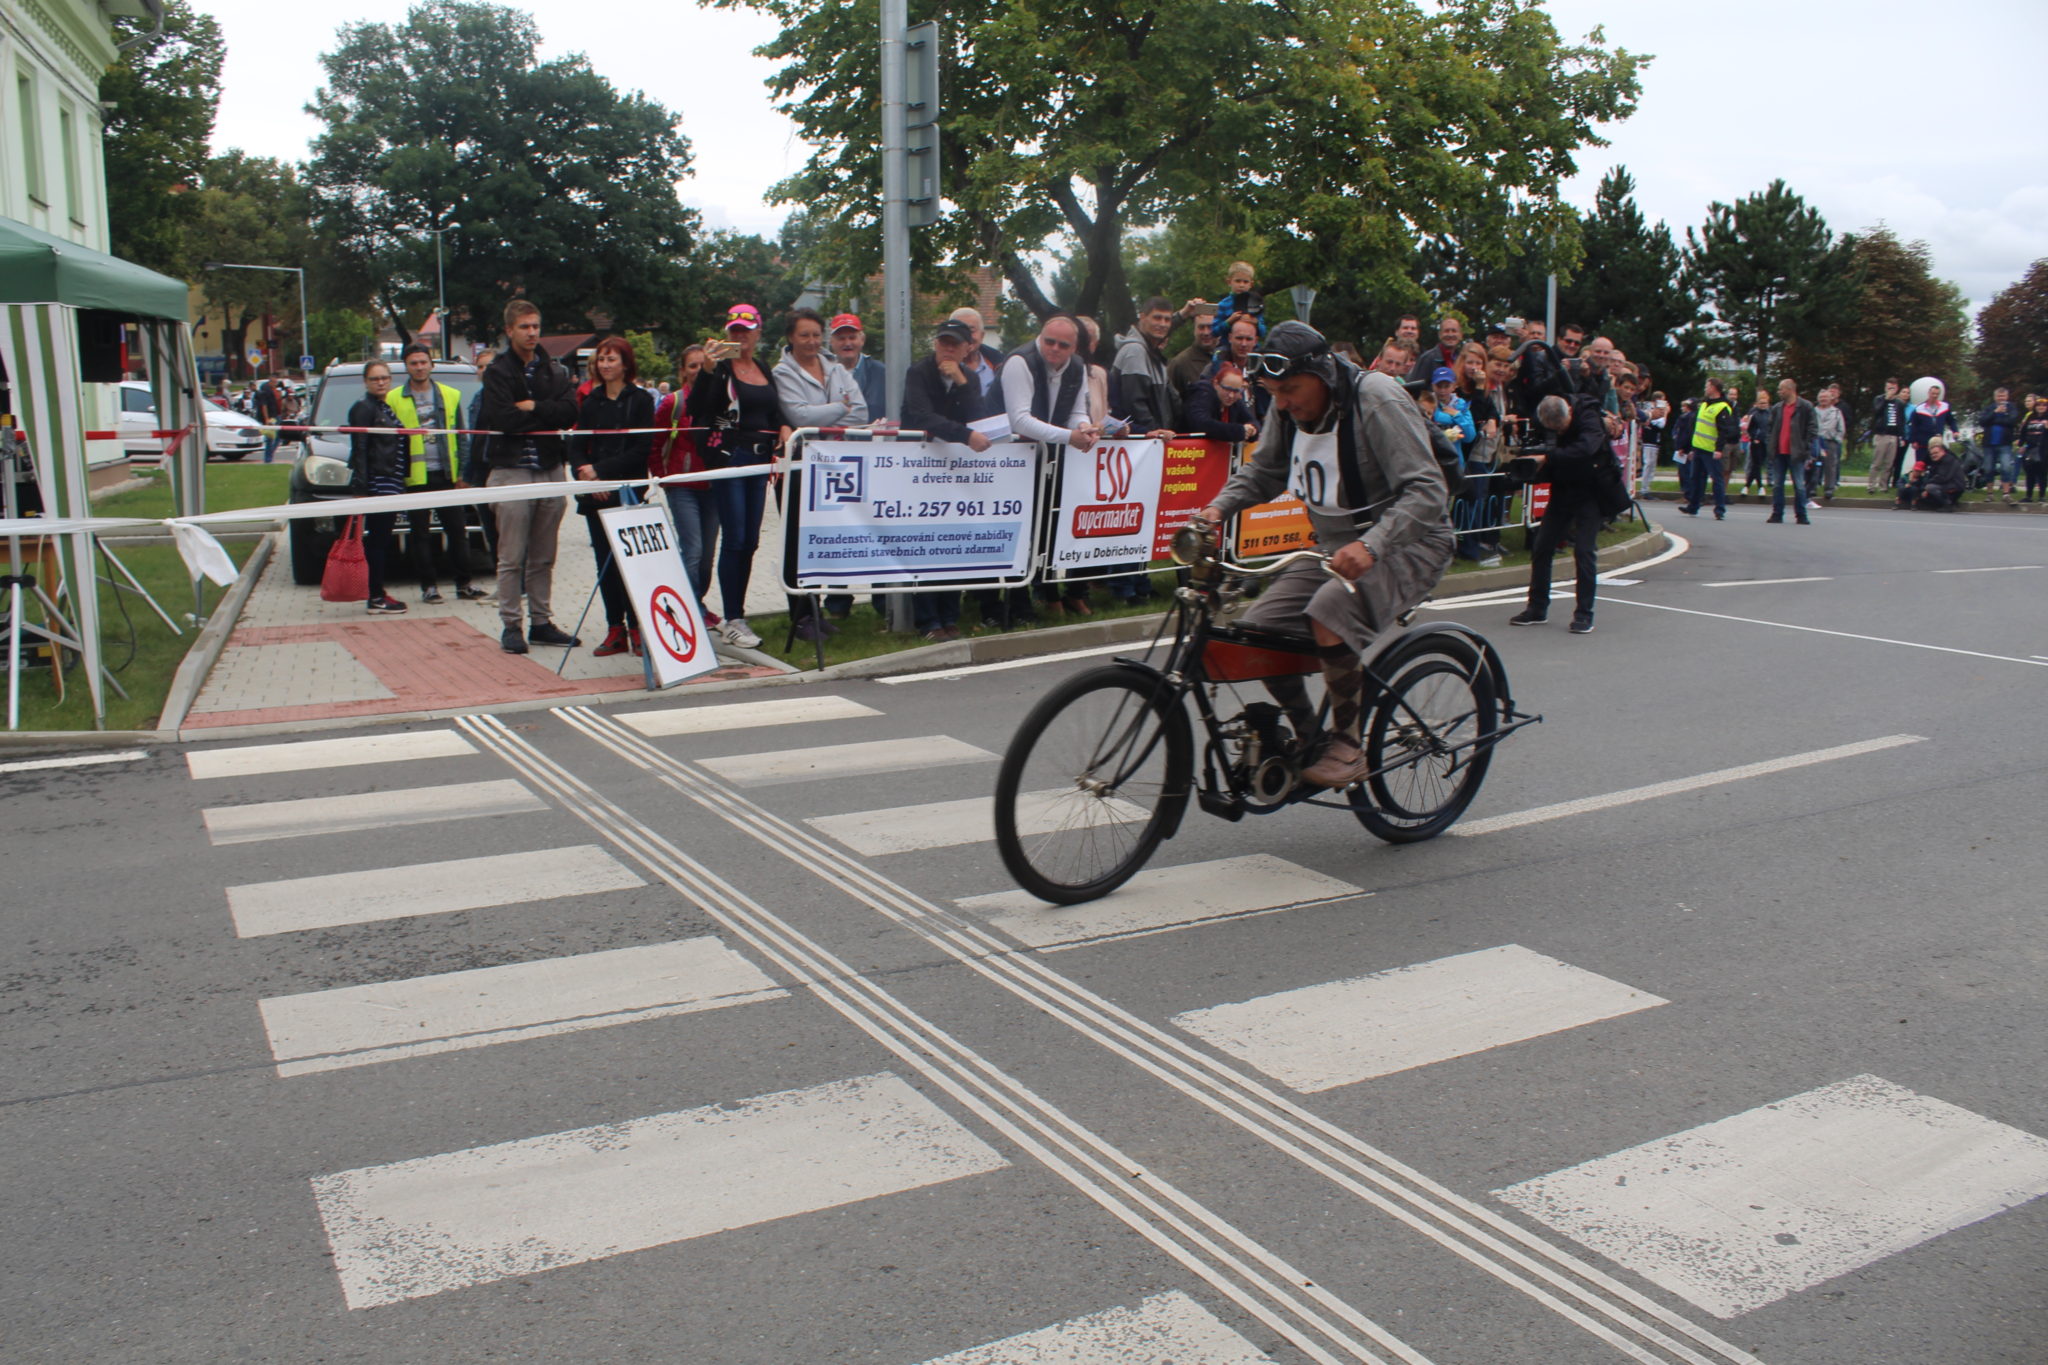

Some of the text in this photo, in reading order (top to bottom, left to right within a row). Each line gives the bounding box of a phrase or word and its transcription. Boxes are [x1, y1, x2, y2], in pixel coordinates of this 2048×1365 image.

[811, 453, 836, 463] okna
[1167, 447, 1205, 459] Prodejna
[874, 457, 893, 469] JIS
[902, 456, 948, 468] kvalitní
[950, 457, 997, 470] plastová
[1000, 457, 1026, 468] okna
[1166, 465, 1195, 475] vašeho
[913, 476, 920, 484] a
[922, 473, 953, 483] dveře
[956, 475, 970, 483] na
[1095, 446, 1132, 502] ESO
[1163, 483, 1197, 493] regionu
[873, 500, 1022, 518] Tel.: 257 961 150
[1077, 505, 1140, 534] supermarket
[618, 523, 669, 557] START
[877, 531, 934, 544] zpracování
[937, 531, 972, 542] cenové
[974, 529, 1013, 542] nabídky
[1243, 538, 1259, 549] 311
[1263, 535, 1279, 546] 670
[808, 543, 1005, 559] a zaměření stavebních otvorů zdarma!
[1060, 549, 1082, 562] Lety
[1085, 550, 1090, 559] u
[1093, 544, 1147, 557] Dobřichovic
